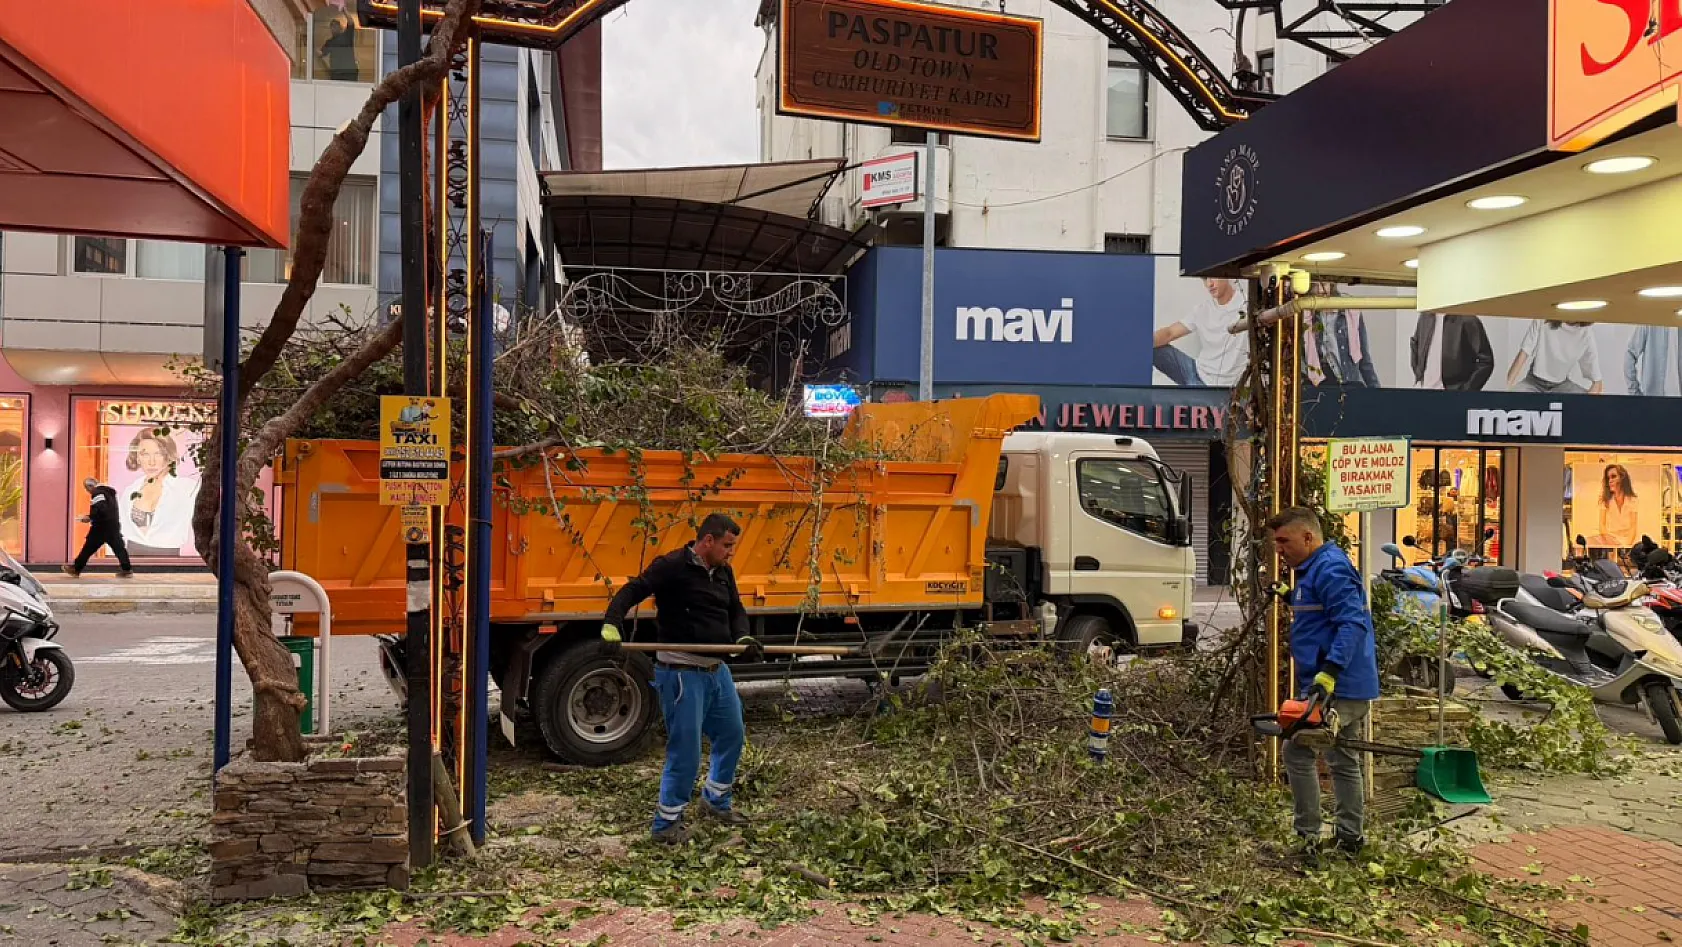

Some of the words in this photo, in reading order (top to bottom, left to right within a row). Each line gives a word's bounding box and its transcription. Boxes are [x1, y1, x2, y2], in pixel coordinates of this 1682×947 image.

[828, 11, 998, 60] PASPATUR
[854, 49, 900, 73] OLD
[909, 56, 975, 82] TOWN
[813, 71, 943, 101] CUMHURİYET
[949, 91, 1012, 109] KAPISI
[871, 170, 892, 183] KMS
[1215, 148, 1237, 187] HAND
[1239, 144, 1260, 171] MADE
[956, 298, 1073, 343] mavi
[1057, 403, 1227, 430] JEWELLERY
[1467, 402, 1563, 437] mavi
[393, 433, 437, 445] TAXI
[1342, 444, 1357, 455] BU
[1360, 443, 1394, 454] ALANA
[1354, 457, 1368, 468] VE
[1371, 456, 1404, 468] MOLOZ
[1340, 470, 1394, 483] BIRAKMAK
[1342, 483, 1392, 496] YASAKTIR
